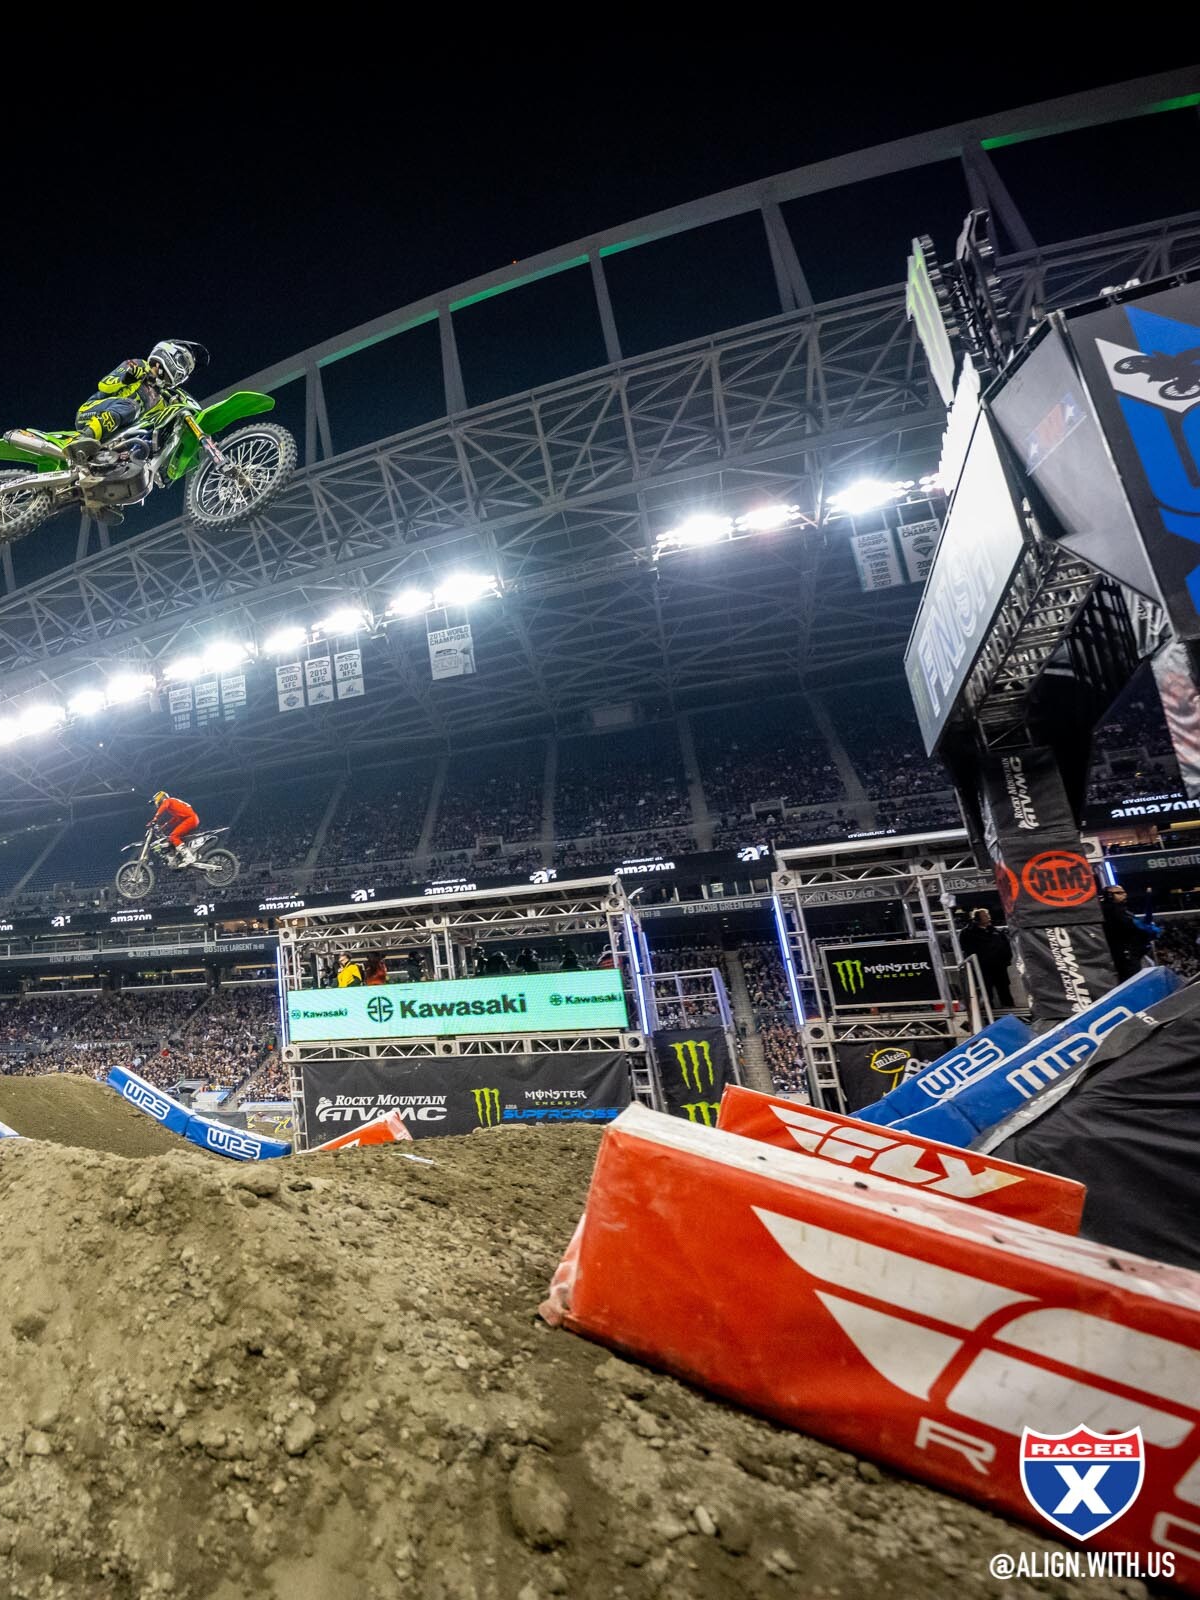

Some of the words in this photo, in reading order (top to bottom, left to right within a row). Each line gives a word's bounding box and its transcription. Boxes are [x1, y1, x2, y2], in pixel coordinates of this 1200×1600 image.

[902, 526, 938, 538] CHAMPS
[310, 668, 328, 678] 2013
[339, 662, 358, 672] 2014
[282, 675, 298, 684] 2005
[1000, 757, 1018, 796] MOUNTAIN
[1012, 795, 1026, 820] ROCKY
[1111, 799, 1200, 818] amazon
[1146, 857, 1168, 869] 96
[1168, 854, 1200, 868] CORTE
[614, 862, 676, 876] amazon
[424, 882, 477, 896] amazon
[259, 900, 305, 910] amazon
[682, 906, 695, 914] 79
[695, 904, 718, 914] JACOB
[720, 902, 744, 911] GREEN
[110, 914, 152, 923] amazon
[203, 946, 214, 954] 80
[214, 944, 229, 952] STEVE
[230, 942, 253, 952] LARGENT
[1046, 928, 1069, 976] MOUNTAIN
[50, 956, 64, 964] RING
[73, 954, 94, 962] HONOR
[864, 962, 931, 974] MONSTER
[1060, 975, 1076, 1001] ROCKY
[564, 992, 622, 1006] Kawasaki
[400, 993, 528, 1019] Kawasaki
[302, 1008, 348, 1020] Kawasaki
[917, 1037, 1005, 1099] WPS
[123, 1080, 170, 1121] WPS
[335, 1094, 374, 1106] ROCKY
[376, 1094, 448, 1106] MOUNTAIN
[524, 1089, 588, 1100] MONSTER
[503, 1108, 618, 1120] SUPERCROSS
[208, 1128, 262, 1160] WPS
